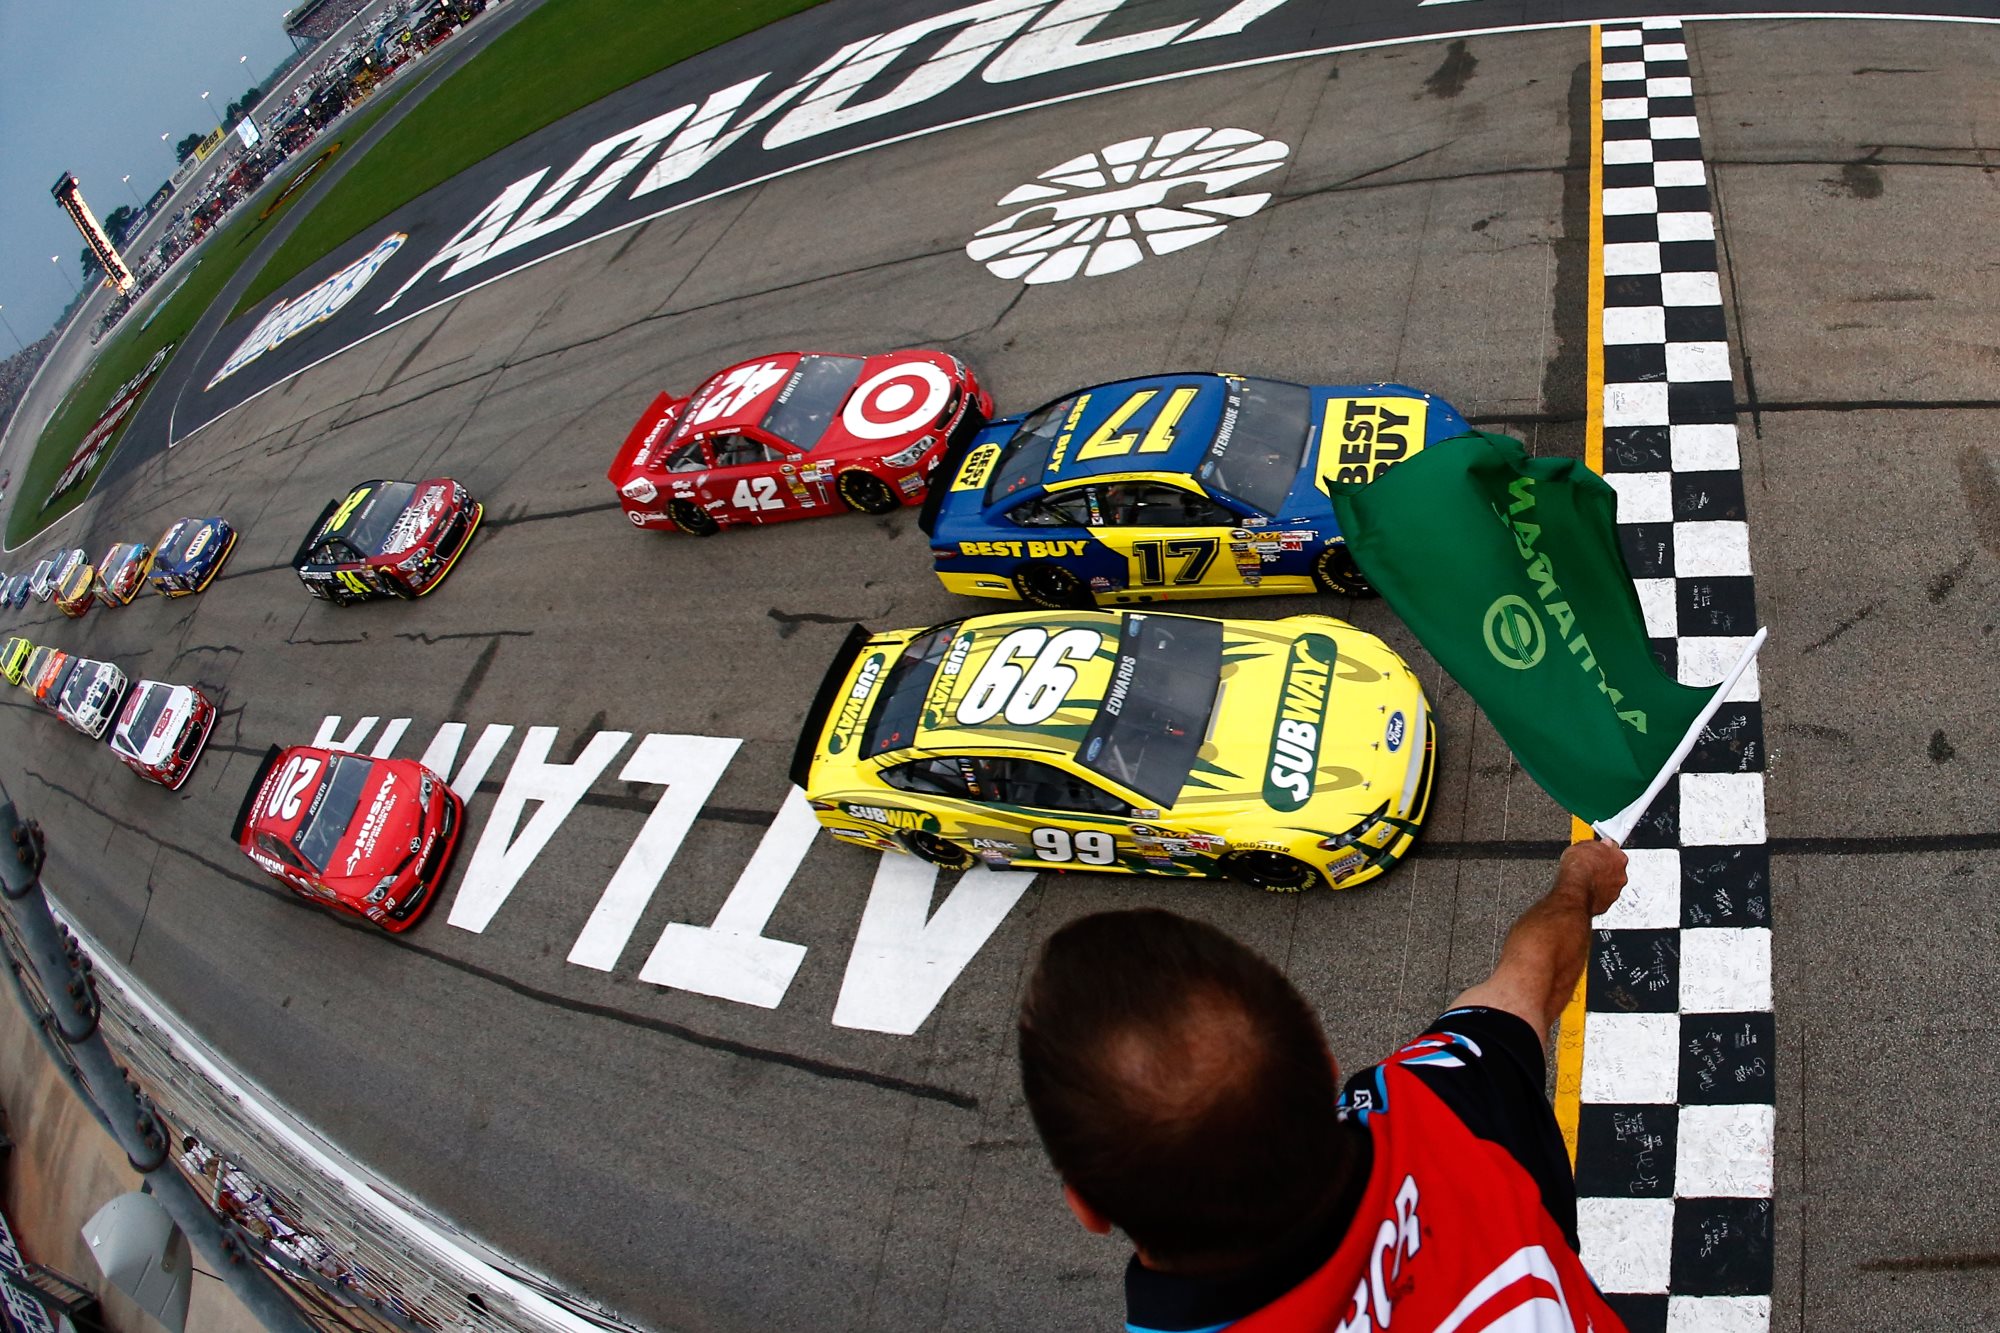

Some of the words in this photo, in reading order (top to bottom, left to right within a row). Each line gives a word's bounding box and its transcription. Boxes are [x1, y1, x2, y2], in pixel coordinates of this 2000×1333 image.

[200, 131, 219, 154] JEGS
[694, 361, 789, 427] 42
[776, 372, 805, 406] MONTOYA
[1064, 393, 1092, 431] BEST
[1076, 388, 1199, 461] 17
[1211, 408, 1239, 457] STENHOUSE
[1229, 395, 1241, 408] JR
[1048, 433, 1071, 473] BUY
[1337, 400, 1377, 484] BEST
[926, 454, 940, 472] 42
[958, 452, 982, 486] BUY
[972, 448, 995, 487] BEST
[324, 487, 372, 535] 24
[732, 476, 786, 512] 42
[187, 529, 210, 557] NAPA
[958, 541, 1024, 558] BEST
[1027, 540, 1088, 558] BUY
[1132, 538, 1219, 587] 17
[1281, 541, 1302, 551] 3M
[336, 570, 372, 594] 24
[931, 637, 971, 727] SUBWAY
[956, 628, 1102, 725] 99
[1105, 656, 1136, 717] EDWARDS
[835, 657, 880, 748] SUBWAY
[1271, 639, 1331, 802] SUBWAY
[268, 756, 322, 820] 20
[308, 782, 328, 816] KENSETH
[355, 772, 397, 848] HUSKY
[364, 825, 381, 853] TOUGH
[376, 800, 392, 826] TOOLS
[366, 837, 380, 859] THAT
[374, 813, 391, 838] NEVER
[385, 794, 398, 814] QUIT
[849, 804, 932, 831] SUBWAY
[415, 827, 437, 876] CAMRY
[973, 838, 1018, 851] Aflac
[1031, 827, 1116, 866] 99
[1188, 840, 1212, 852] 3M
[1229, 842, 1290, 854] GOODYEAR
[1376, 824, 1392, 842] 99
[385, 898, 396, 909] 20
